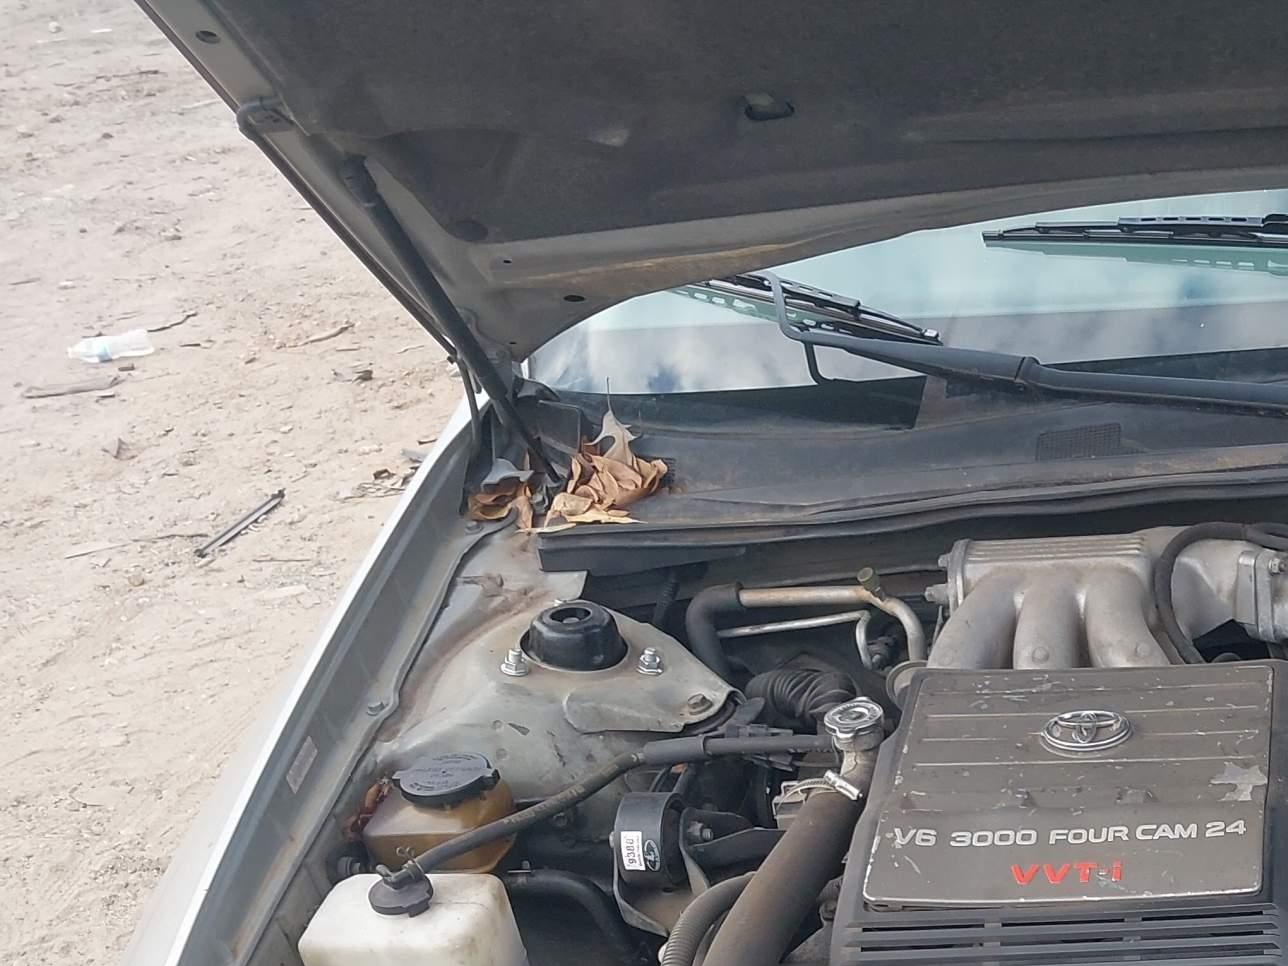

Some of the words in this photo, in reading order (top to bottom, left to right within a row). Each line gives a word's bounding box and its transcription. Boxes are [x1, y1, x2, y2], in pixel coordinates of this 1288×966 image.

[893, 827, 937, 847] V6
[949, 828, 1038, 848] 3000
[1047, 826, 1130, 846] FOUR
[1135, 823, 1198, 842] CAM
[1204, 819, 1248, 838] 24
[1010, 859, 1123, 886] VVT-i
